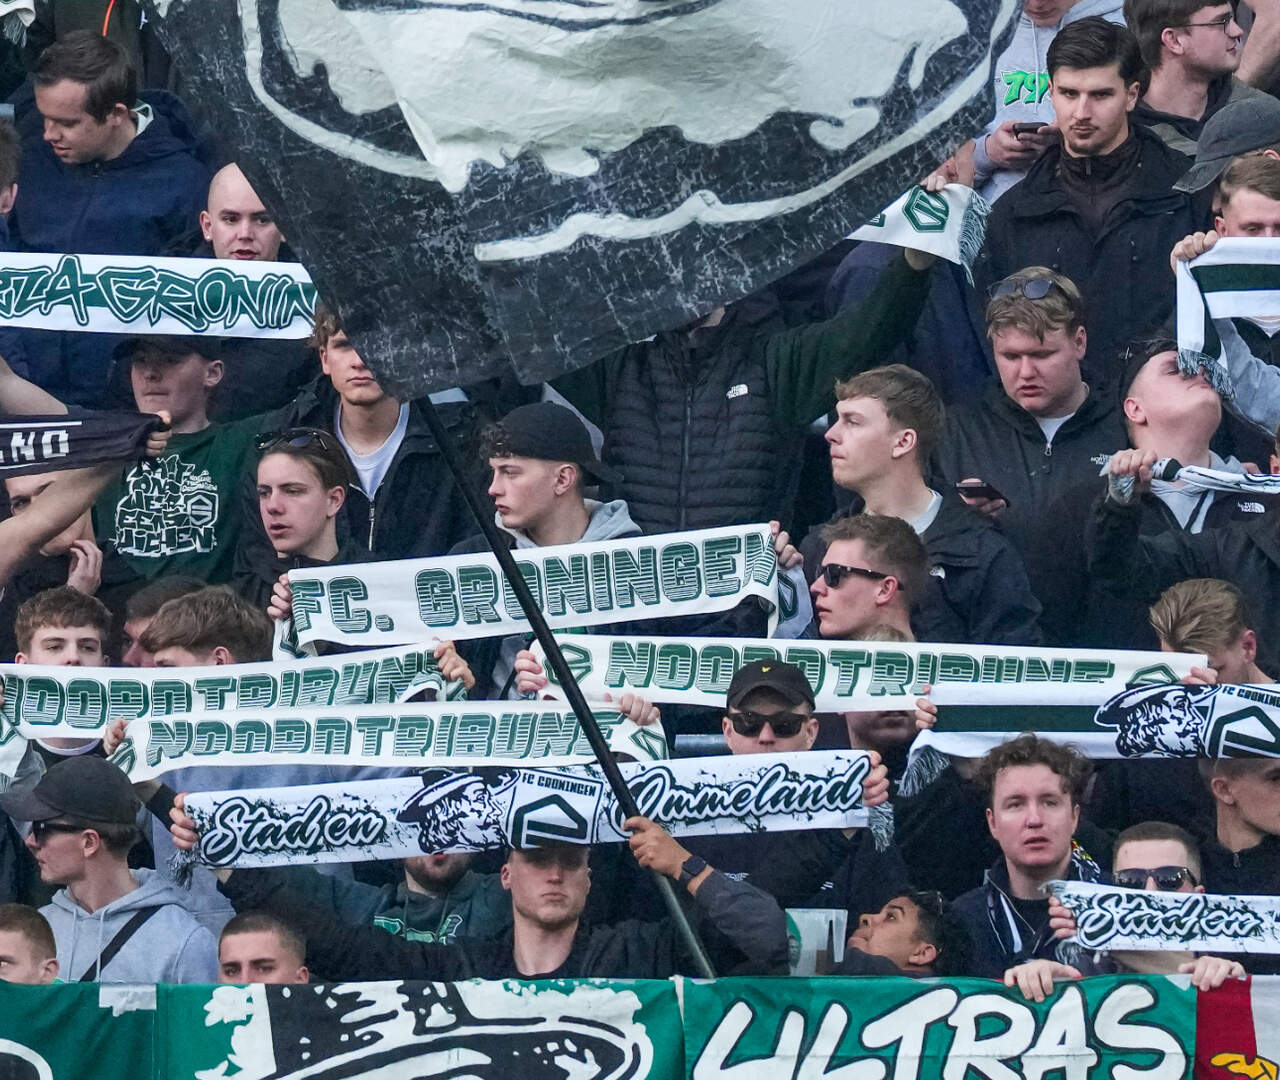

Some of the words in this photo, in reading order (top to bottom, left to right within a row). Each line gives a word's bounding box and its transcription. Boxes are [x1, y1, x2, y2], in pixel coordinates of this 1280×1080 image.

[96, 266, 320, 332] GRONIN
[1222, 685, 1236, 696] FC
[521, 772, 536, 785] FC
[537, 775, 598, 797] GRONINGEN
[692, 982, 1188, 1080] ULTRAS
